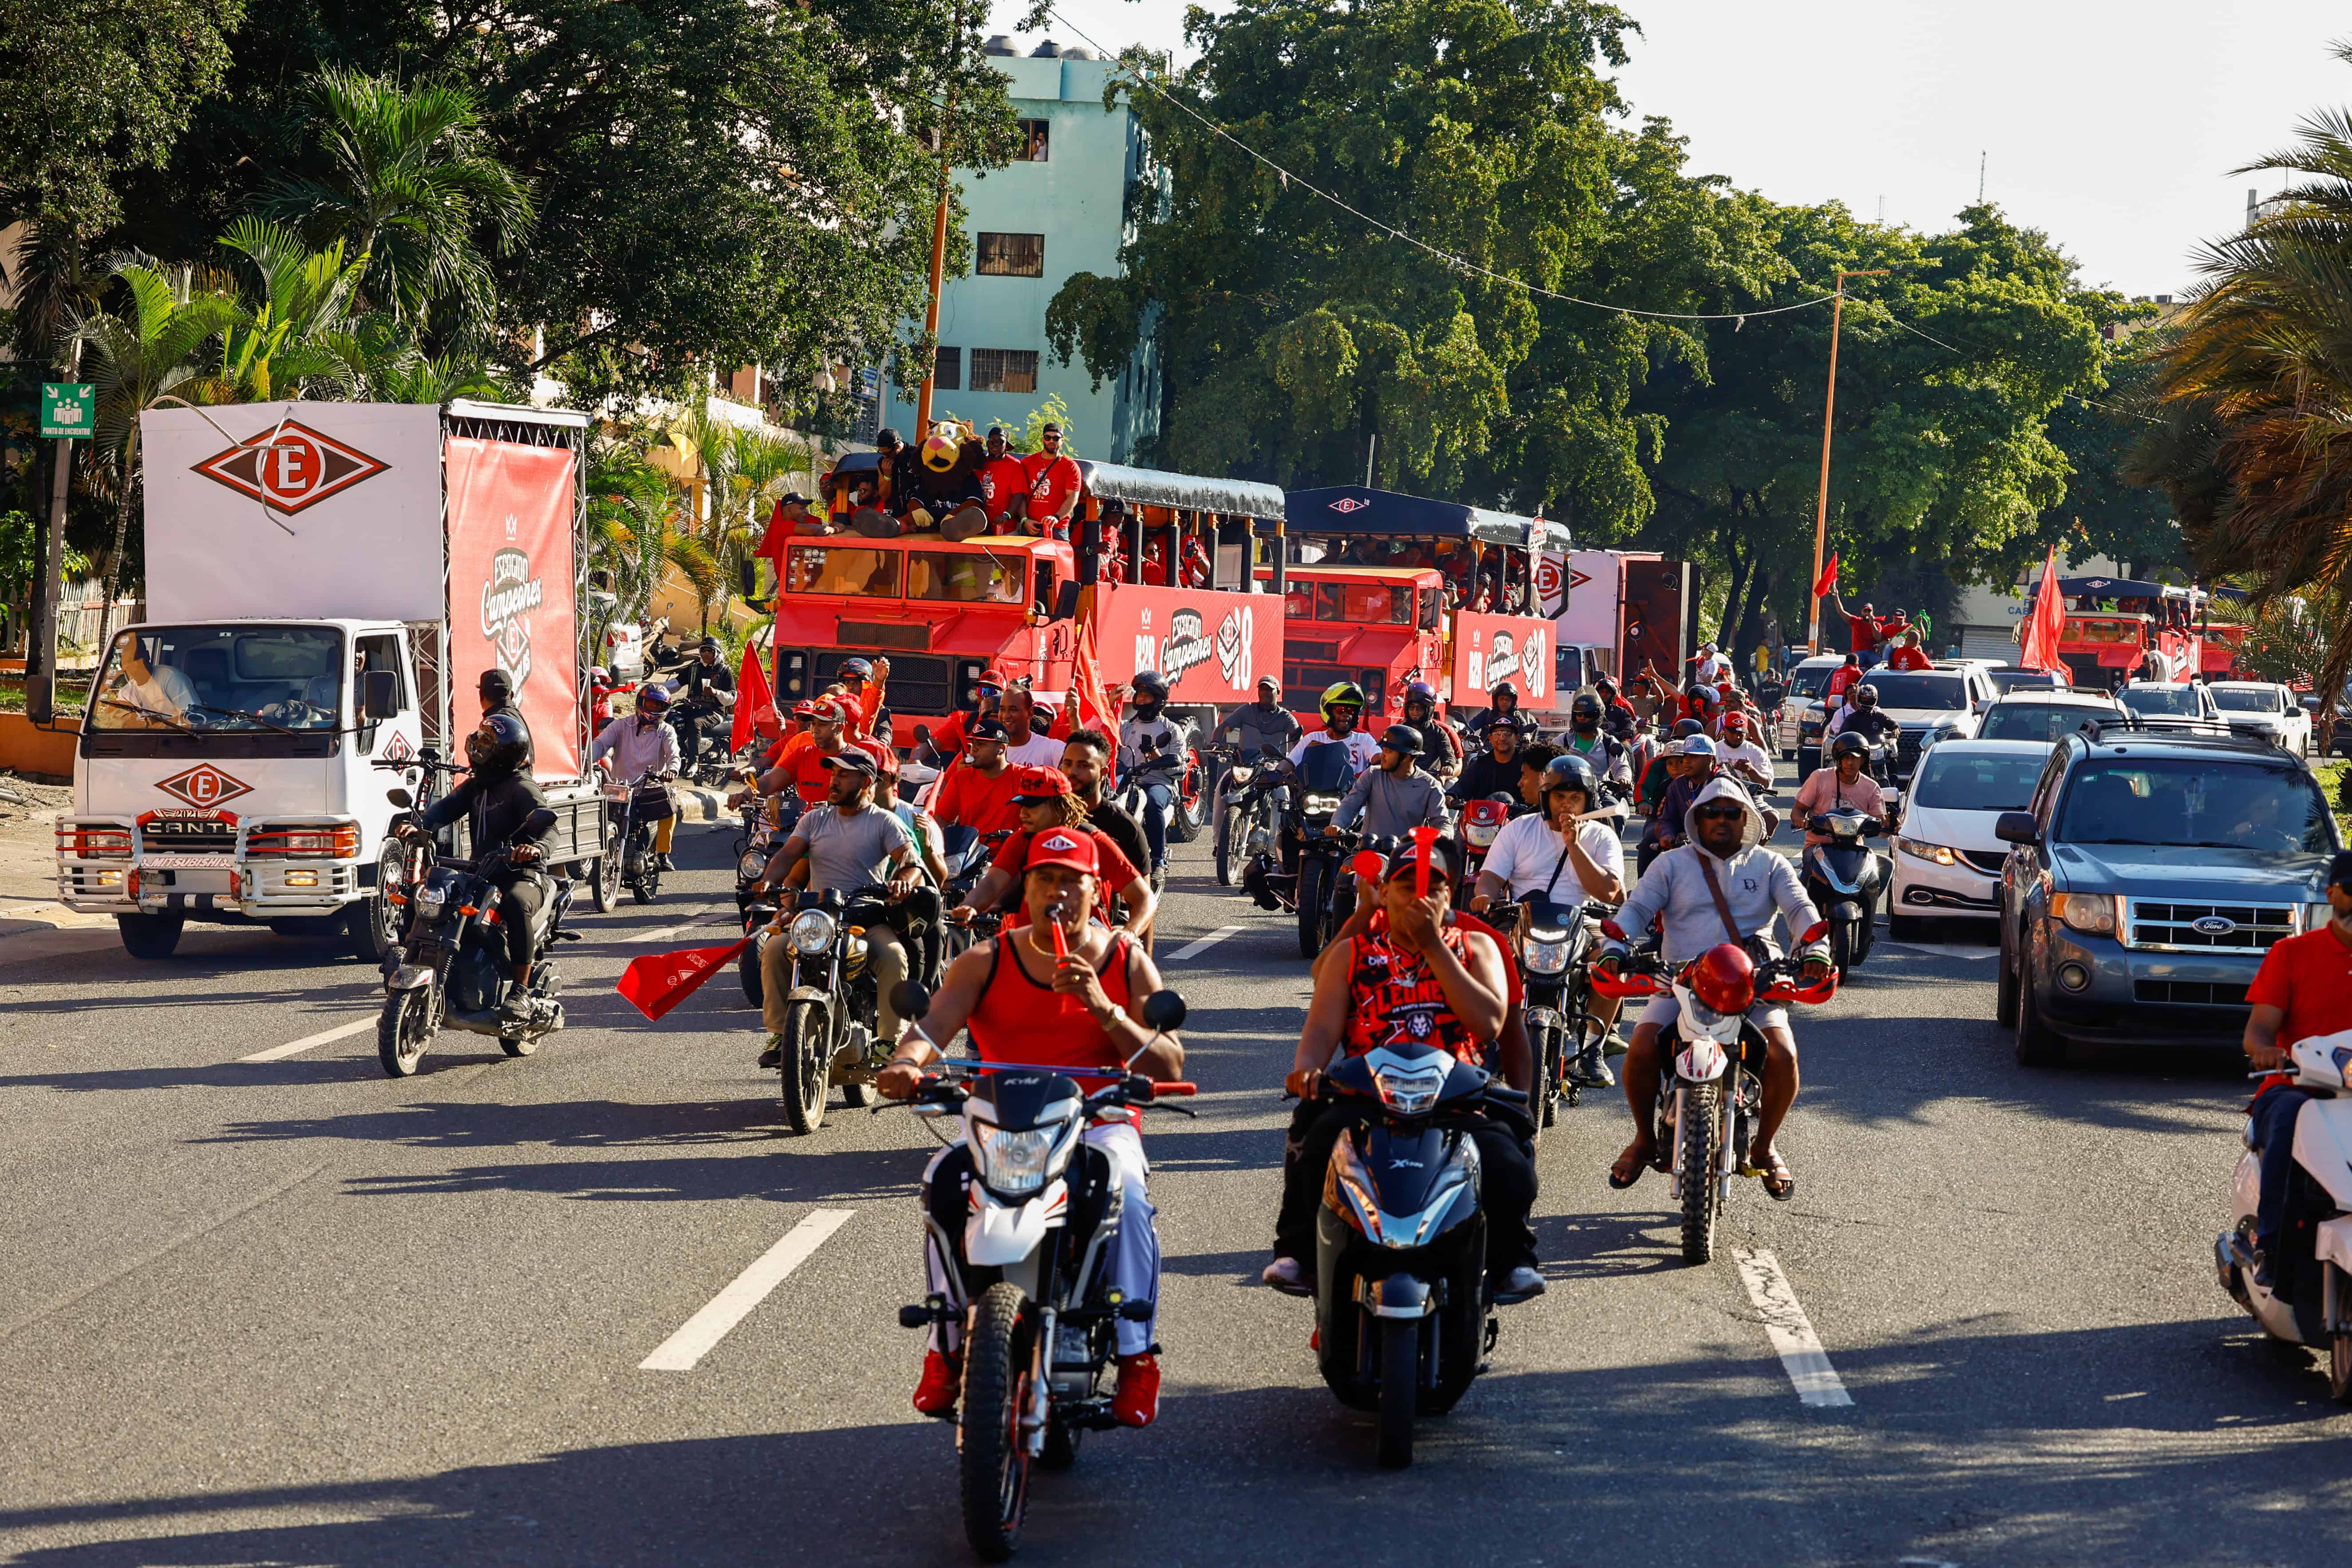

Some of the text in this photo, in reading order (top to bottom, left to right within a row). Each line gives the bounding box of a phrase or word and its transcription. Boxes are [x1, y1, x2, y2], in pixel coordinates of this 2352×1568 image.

[277, 444, 306, 489] E
[1344, 501, 1350, 510] E
[1539, 569, 1552, 589] E
[481, 578, 541, 636] Campeones
[1172, 614, 1201, 644] ESCOGIDO
[1159, 635, 1212, 683] Campeones
[197, 775, 212, 798] E
[174, 809, 199, 819] 2021
[151, 857, 224, 867] MITSUBISHI
[2203, 921, 2223, 929] Ford
[1376, 979, 1443, 1015] LEONE
